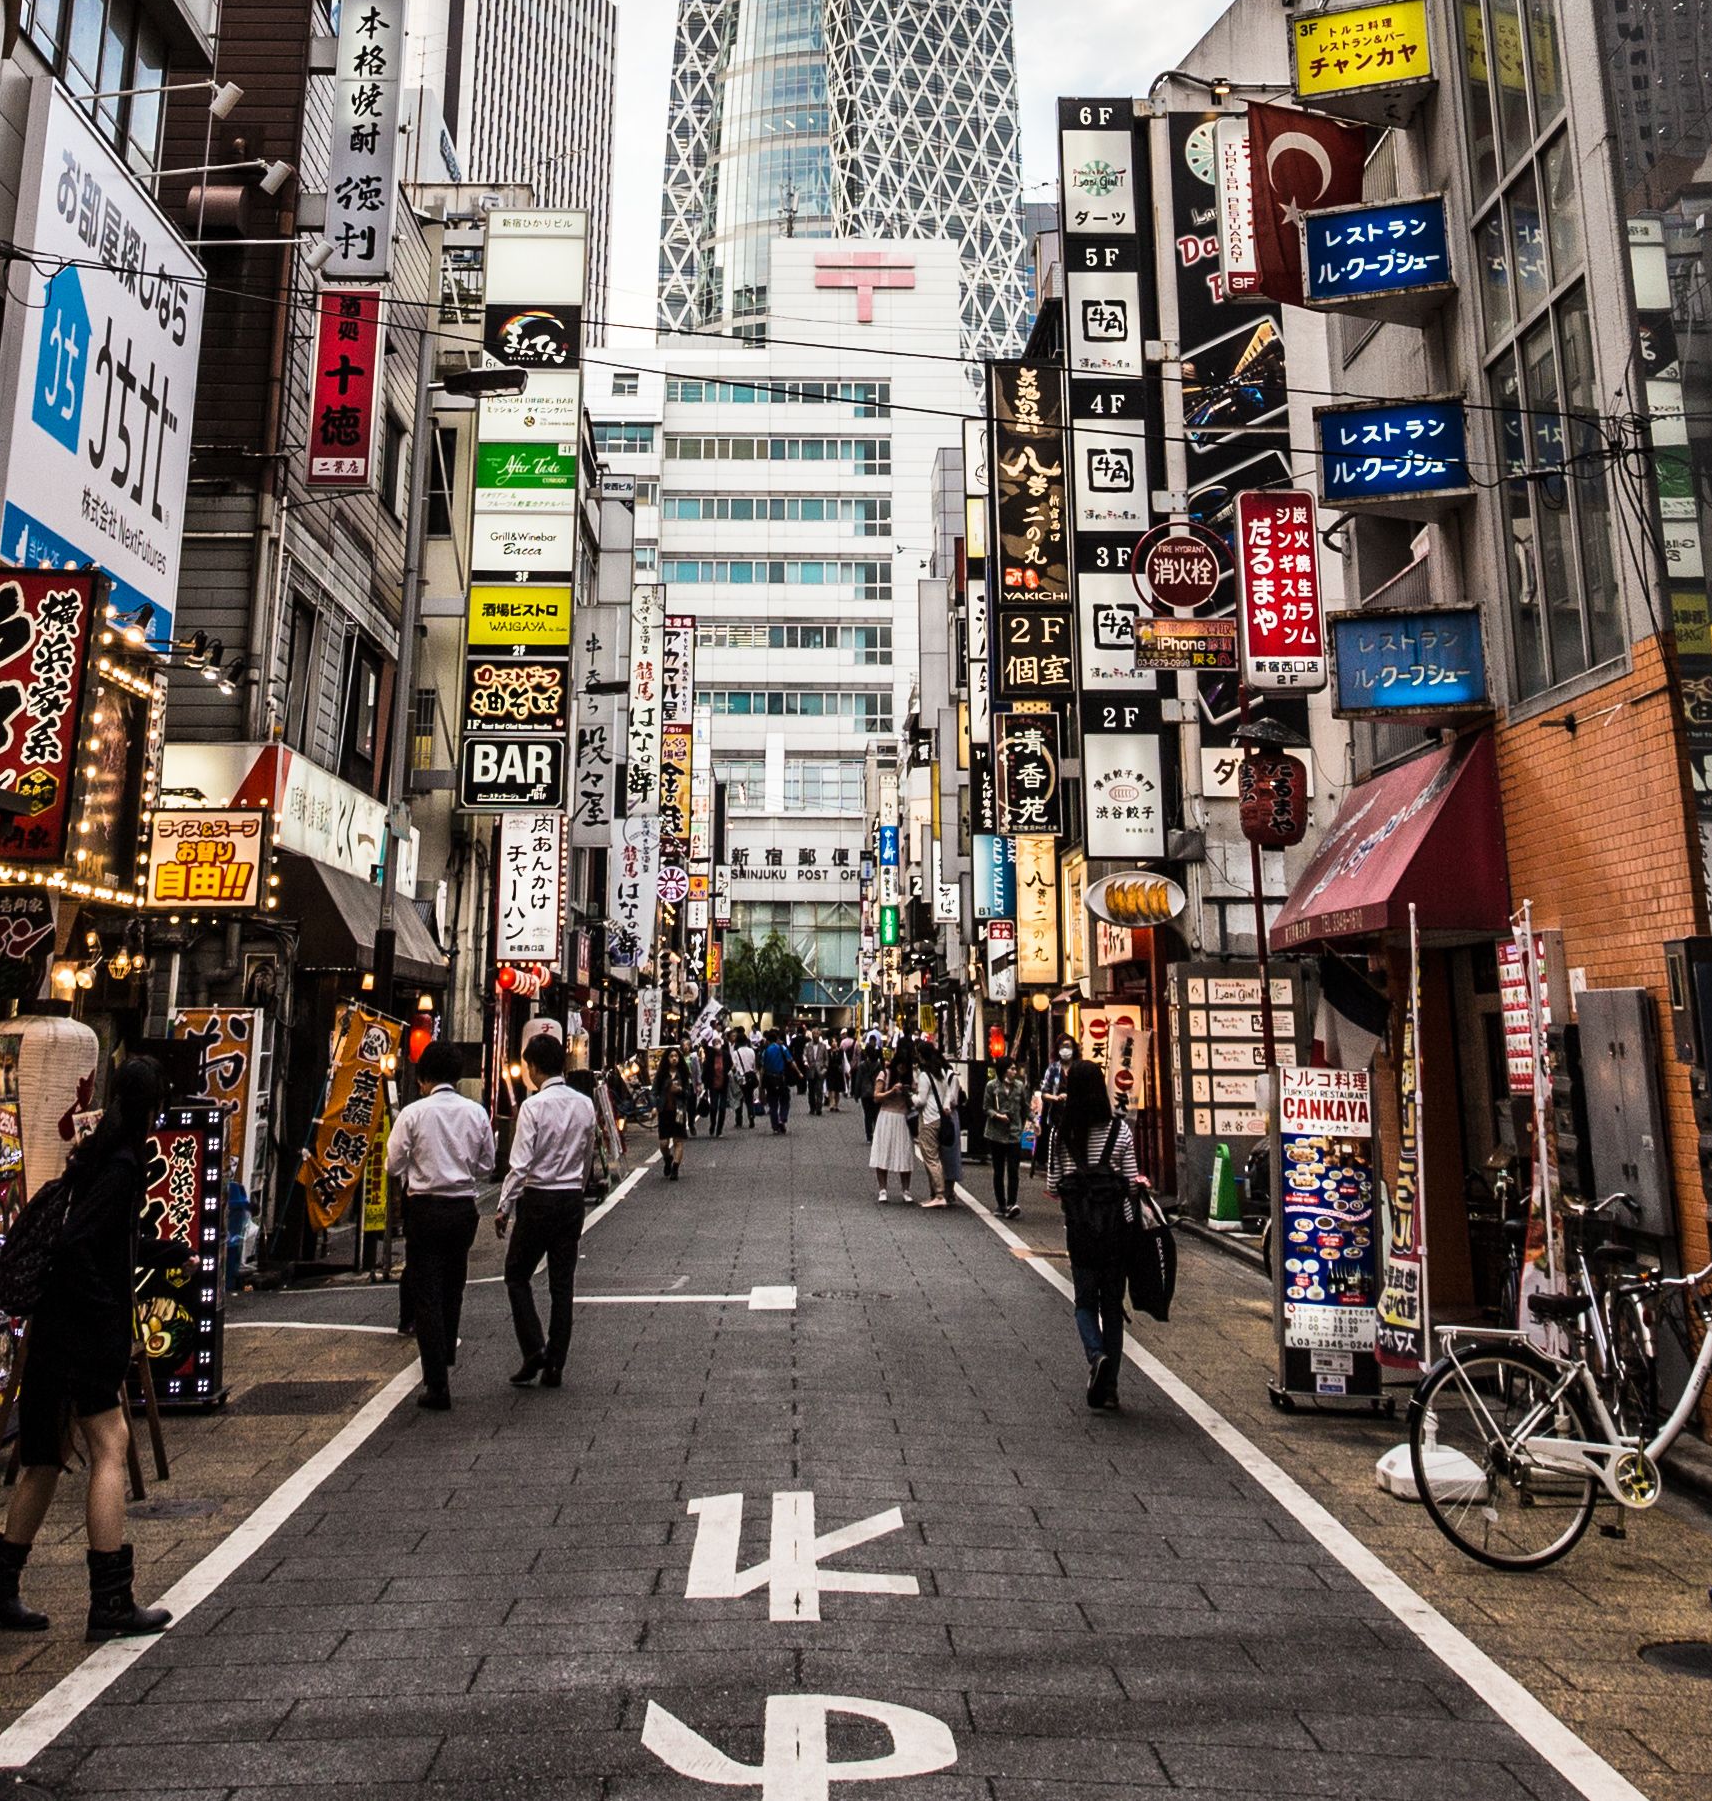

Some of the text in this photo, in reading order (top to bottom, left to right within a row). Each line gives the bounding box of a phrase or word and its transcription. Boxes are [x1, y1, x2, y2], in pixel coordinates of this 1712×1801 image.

[1299, 16, 1394, 39] 3F トルコ料理
[1318, 30, 1407, 55] レストラン&バー
[1309, 42, 1420, 81] チャンカヤ
[347, 5, 391, 157] 本格焼酎
[1079, 107, 1114, 126] 6F
[1224, 141, 1241, 192] TURKISH
[332, 174, 387, 263] 徳利
[502, 217, 574, 230] 新宿ひかりビル
[1074, 209, 1128, 227] ダーツ
[1324, 218, 1428, 248] レストラン
[55, 147, 190, 349] お部屋探しなら
[1084, 247, 1121, 268] 5F
[1230, 276, 1256, 289] 3F
[1088, 307, 1124, 335] 牛角
[319, 355, 369, 452] 十徳
[1090, 393, 1126, 415] 4F
[1340, 418, 1447, 446] レストラン
[497, 454, 561, 486] After Taste
[1093, 454, 1130, 483] 牛角
[81, 484, 118, 540] 株式会社
[118, 514, 167, 576] NextFutures
[1048, 494, 1062, 544] 新宿西口
[490, 531, 557, 543] Grill&Winebar
[1022, 505, 1048, 566] 二の丸
[1158, 545, 1206, 554] FIRE HYDRANT
[1096, 545, 1132, 568] 3F
[514, 571, 530, 583] 3F
[1153, 557, 1214, 586] 消火栓
[1247, 518, 1280, 637] だるまや
[1275, 507, 1299, 647] ジンギスカン
[1291, 507, 1317, 646] 炭火焼生ラム
[482, 602, 559, 618] 酒場ビストロ
[1003, 591, 1069, 602] YAKICHI
[489, 621, 547, 633] WAIGAYA
[1009, 617, 1066, 644] 2F
[512, 645, 526, 656] 2F
[1156, 636, 1207, 651] iPhone
[1358, 631, 1460, 655] レストラン
[22, 589, 83, 765] 横浜家系
[663, 630, 681, 722] アカマル屋
[1004, 653, 1072, 687] 個室
[1254, 659, 1320, 675] 新宿西口店
[1275, 673, 1300, 687] 2F
[633, 661, 656, 703] 龍馬
[473, 685, 560, 718] 油そば
[467, 719, 482, 730] 1F
[1102, 707, 1139, 728] 2F
[473, 744, 552, 785] BAR
[628, 706, 658, 805] はなの舞
[574, 725, 614, 829] 段々屋
[1013, 726, 1048, 825] 清香苑
[1095, 805, 1155, 821] 渋谷餃子
[1264, 761, 1298, 837] だるまや
[157, 817, 260, 839] ライス&スープ
[175, 840, 234, 862] お替り
[530, 814, 555, 912] 肉あんかけ
[731, 847, 850, 867] 新宿郵便
[992, 837, 1003, 865] OLD
[1006, 837, 1017, 864] BAR
[154, 862, 256, 901] 自由!!
[731, 868, 828, 880] SHINJUKU POST
[504, 844, 528, 942] チャーハン
[992, 866, 1005, 916] VALLEY
[978, 906, 993, 916] B1
[1031, 909, 1050, 963] 二の丸
[1282, 1067, 1369, 1092] トルコ料理
[1283, 1088, 1369, 1101] TURKISH RESTAURANT
[1283, 1097, 1370, 1125] ÇANKAYA
[1296, 1337, 1374, 1350] 03-3345-0244
